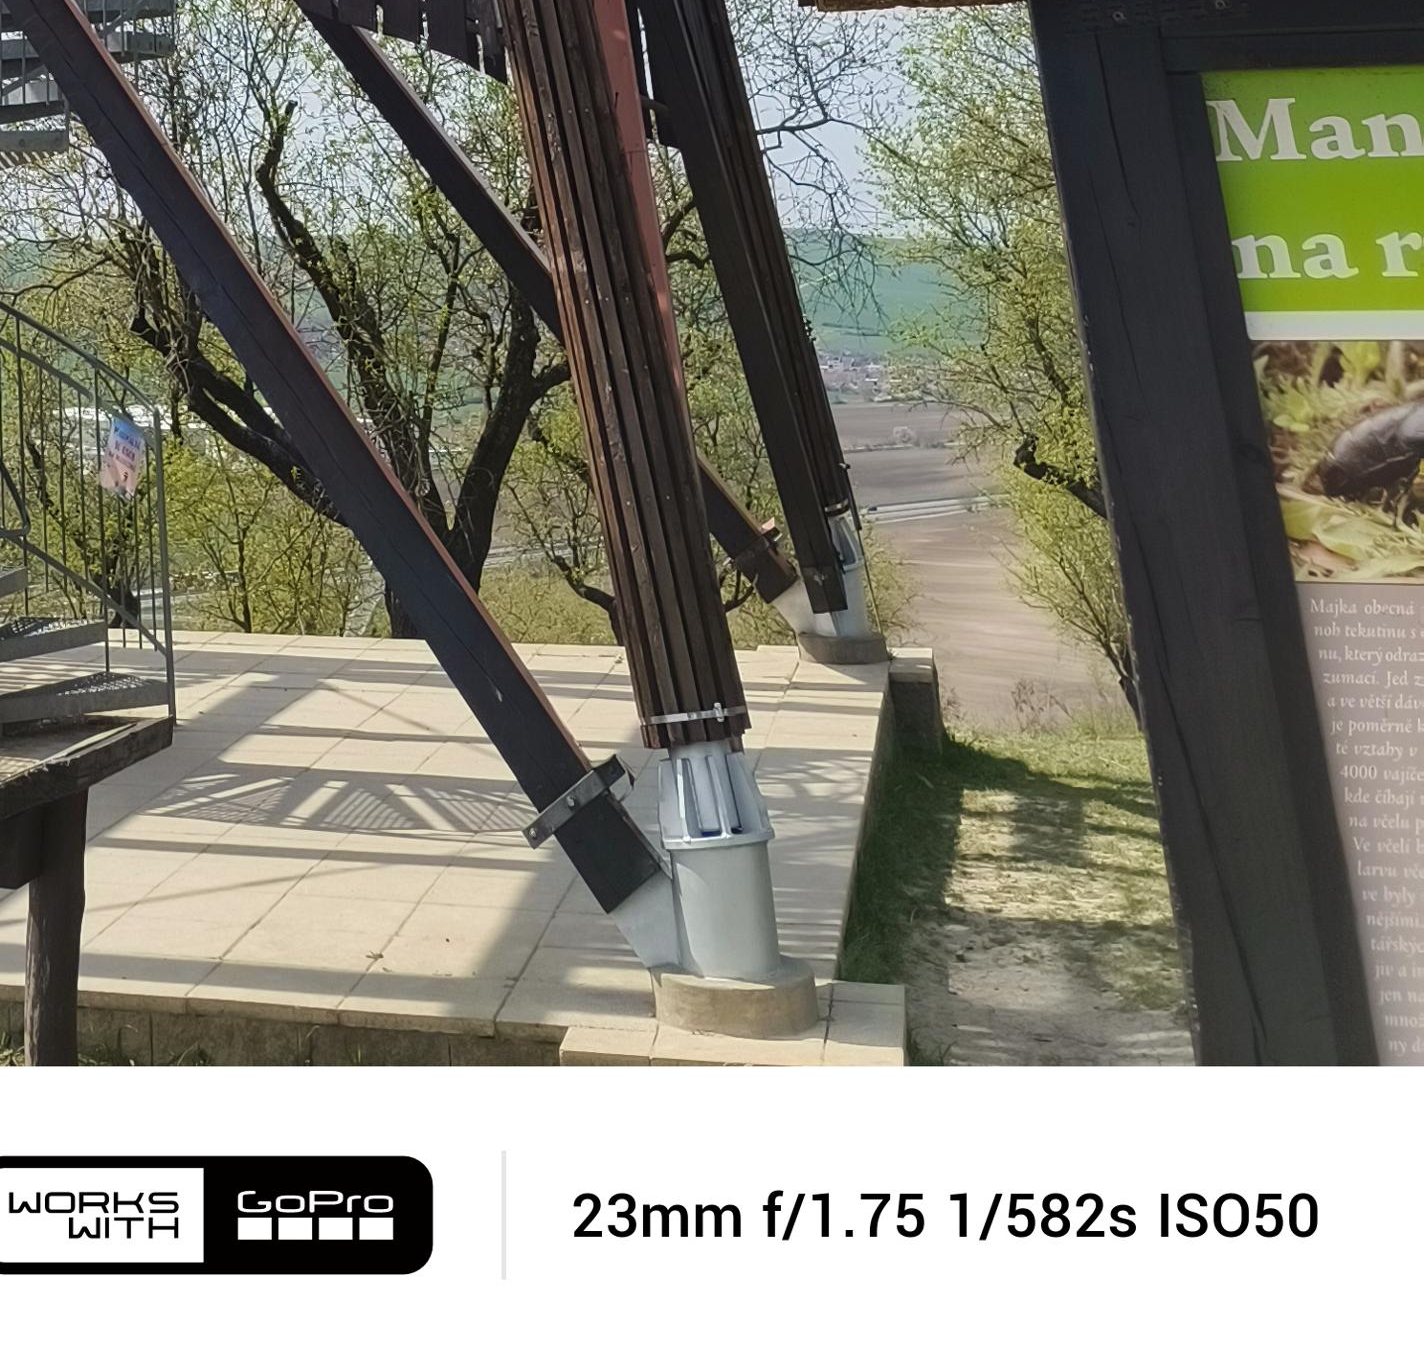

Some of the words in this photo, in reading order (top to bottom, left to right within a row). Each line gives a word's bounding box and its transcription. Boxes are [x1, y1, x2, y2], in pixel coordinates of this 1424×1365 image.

[1232, 234, 1359, 279] na
[1310, 598, 1357, 618] Majka
[1364, 599, 1416, 615] obecná
[1344, 622, 1405, 638] tekutinu
[1345, 645, 1383, 667] který
[1384, 670, 1408, 689] Jed
[1327, 697, 1336, 707] a
[1340, 697, 1356, 708] ve
[1360, 694, 1392, 709] větší
[1395, 693, 1424, 709] dáv
[1330, 717, 1343, 735] je
[1348, 719, 1413, 736] poměrně
[1354, 741, 1403, 762] vztahy
[1340, 765, 1377, 780] 4000
[1344, 787, 1370, 803] kde
[1349, 816, 1367, 828] na
[1373, 813, 1410, 829] včelu
[1353, 836, 1370, 852] Ve
[1383, 885, 1416, 908] byly
